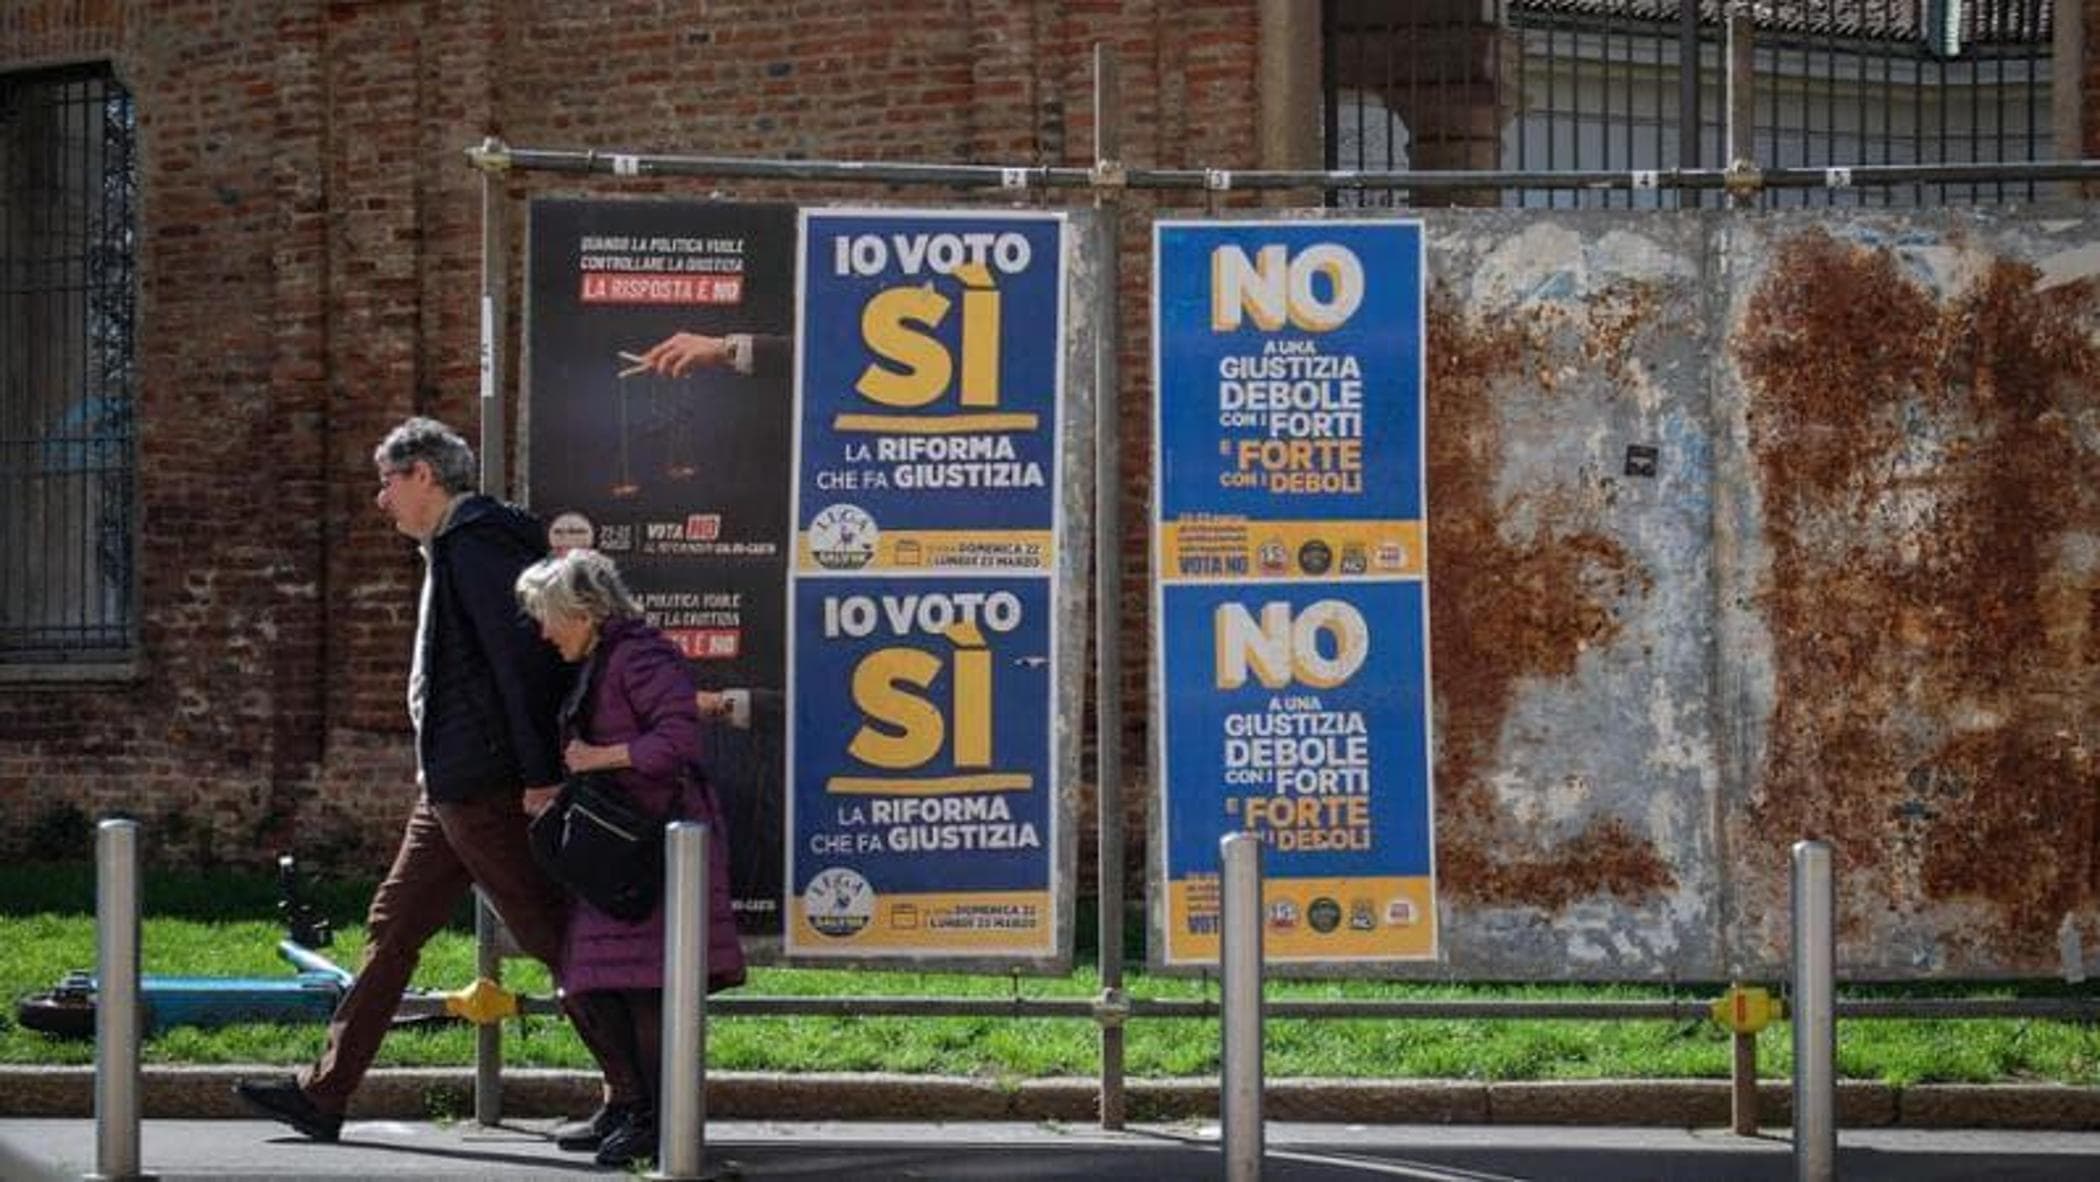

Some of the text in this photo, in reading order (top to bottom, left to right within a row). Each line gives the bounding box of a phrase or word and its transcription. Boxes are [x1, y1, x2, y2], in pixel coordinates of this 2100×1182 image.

[1639, 173, 1649, 188] 4
[631, 238, 648, 252] LA
[649, 238, 703, 253] POLITICA
[836, 234, 1031, 275] IO VOTO
[580, 256, 663, 271] CONTROLLARE
[667, 256, 684, 271] LA
[586, 280, 606, 298] LA
[612, 279, 693, 300] RISPOSTA
[714, 282, 740, 300] NO
[1211, 243, 1365, 332] NO
[855, 263, 1000, 406] SÌ
[1263, 341, 1316, 355] A UNA
[1219, 356, 1360, 380] GIUSTIZIA
[1220, 380, 1362, 411] DEBOLE
[1219, 412, 1256, 427] CON
[1270, 412, 1362, 437] FORTI
[845, 436, 1015, 462] LA RIFORMA
[1238, 440, 1362, 471] FORTE
[817, 462, 1045, 489] CHE FA GIUSTIZIA
[1219, 472, 1257, 487] CON
[1270, 471, 1362, 493] DEBOLI
[647, 519, 717, 540] VOTA NO
[959, 543, 1021, 554] DOMENICA
[997, 557, 1040, 568] MARZO
[1181, 557, 1223, 574] VOTA
[1227, 557, 1248, 574] NO
[646, 594, 700, 607] POLITICA
[825, 592, 1021, 637] IO VOTO
[709, 635, 735, 652] NO
[1216, 600, 1370, 689] NO
[848, 620, 993, 768] SÌ
[1269, 696, 1323, 711] A UNA
[1224, 712, 1367, 736] GIUSTIZIA
[1225, 737, 1368, 767] DEBOLE
[1225, 770, 1263, 784] CON
[1276, 769, 1369, 794] FORTI
[838, 796, 1010, 825] LA RIFORMA
[1245, 797, 1369, 827] FORTE
[810, 822, 1041, 854] CHE FA GIUSTIZIA
[1278, 829, 1370, 850] DEBOLI
[956, 904, 1018, 915] DOMENICA
[996, 916, 1036, 928] MARZO
[1188, 916, 1221, 933] VOT
